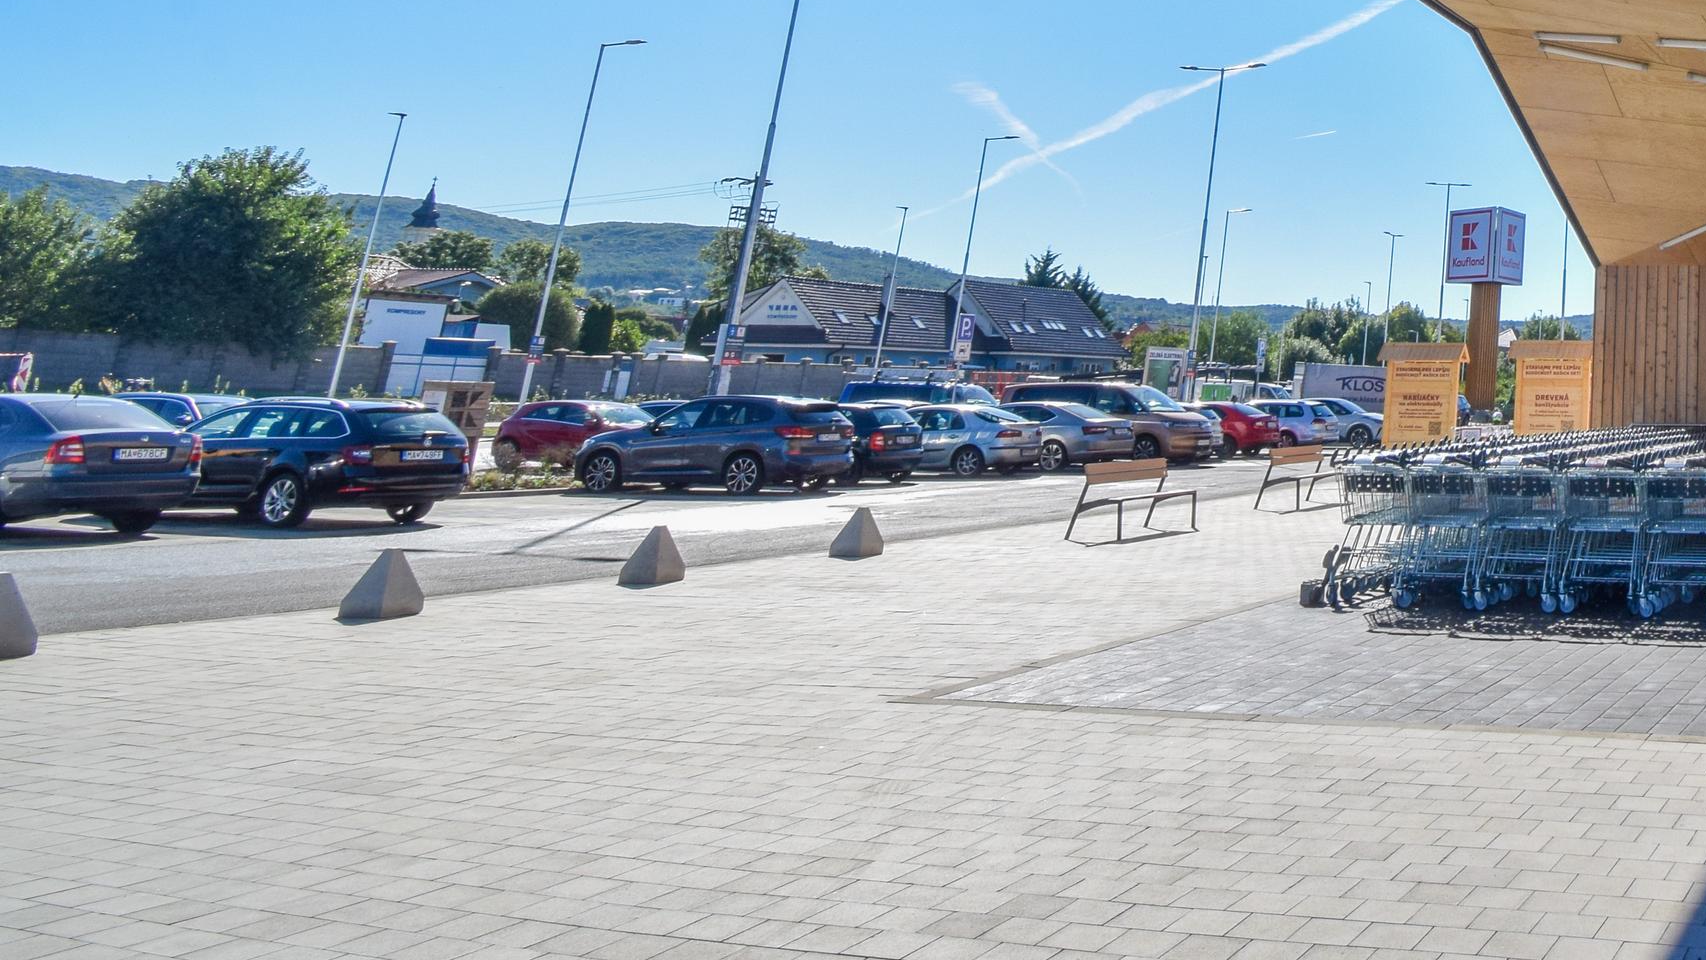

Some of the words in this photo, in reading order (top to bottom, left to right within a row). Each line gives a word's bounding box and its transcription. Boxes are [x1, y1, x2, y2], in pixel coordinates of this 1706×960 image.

[1452, 256, 1485, 267] Kaufland
[1341, 379, 1385, 393] KLOS
[1535, 393, 1569, 401] DREVENÁ
